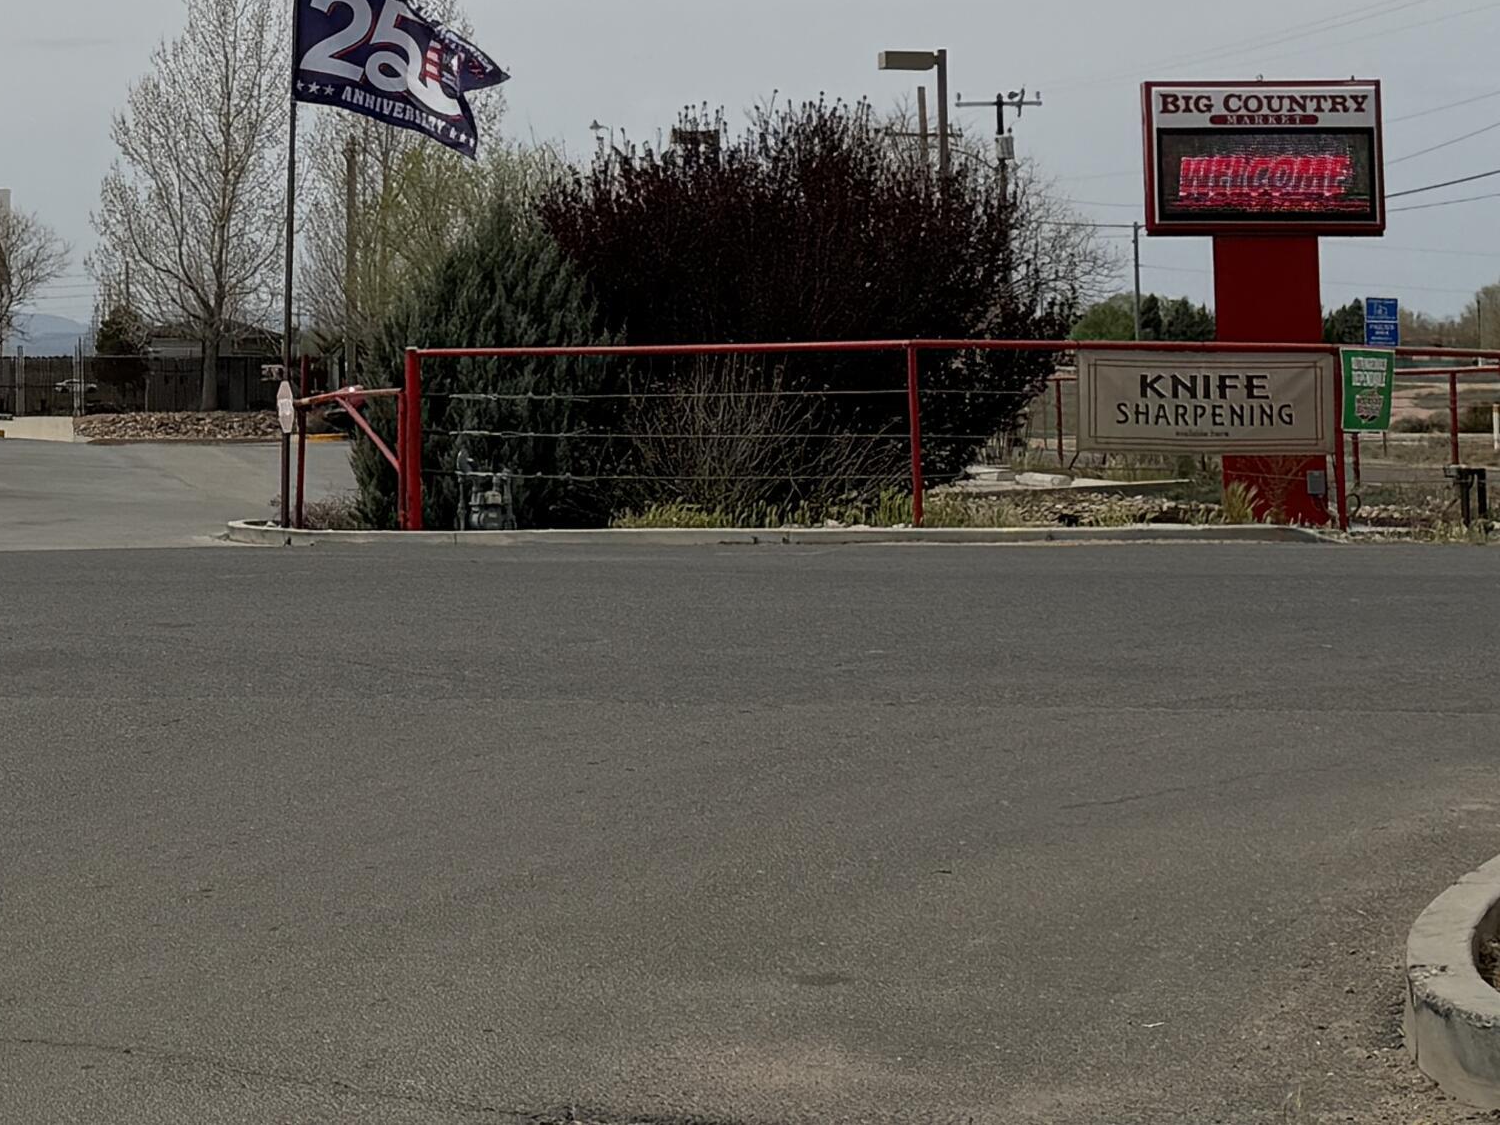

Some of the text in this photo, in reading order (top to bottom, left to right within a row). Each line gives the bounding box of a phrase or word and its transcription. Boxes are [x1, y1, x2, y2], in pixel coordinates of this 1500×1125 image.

[1159, 93, 1369, 114] BIG COUNTRY
[1227, 114, 1301, 125] MARKET
[1139, 373, 1270, 400] KNIFE
[1115, 402, 1294, 427] SHARPENING
